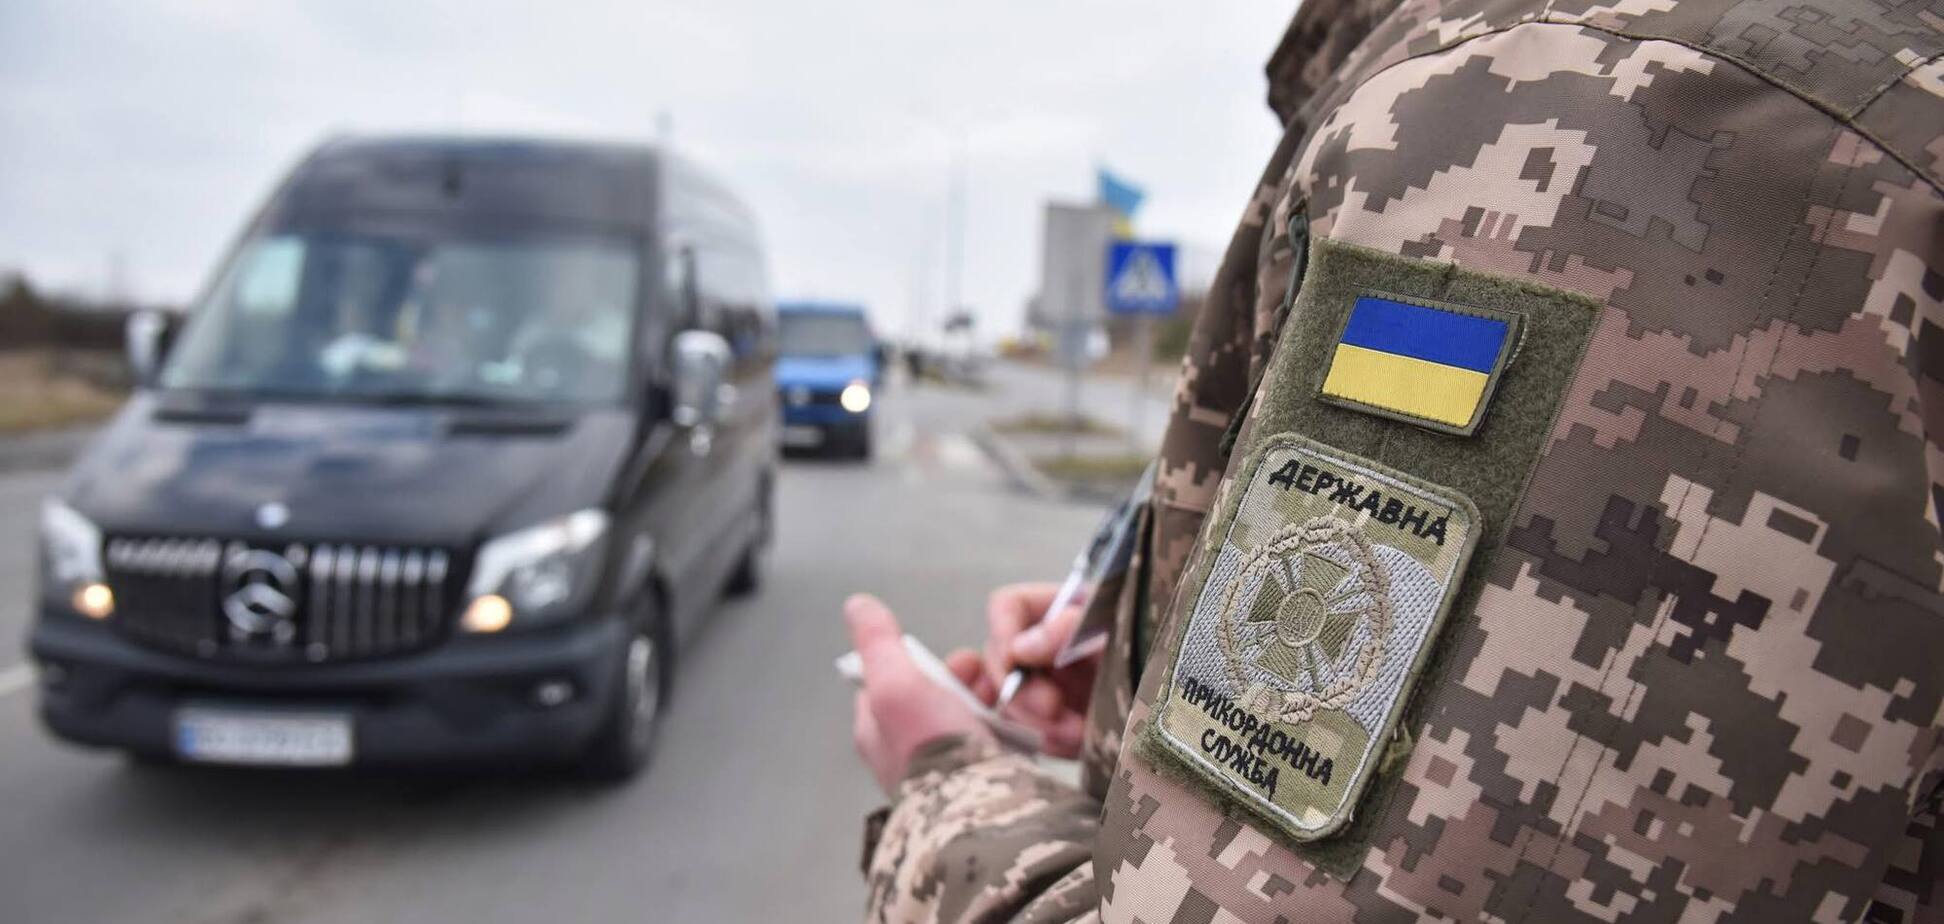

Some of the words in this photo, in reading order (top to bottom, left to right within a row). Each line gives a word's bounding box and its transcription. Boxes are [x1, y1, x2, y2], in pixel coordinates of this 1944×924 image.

[1268, 458, 1448, 546] ДЕРЖАВНА
[1182, 677, 1334, 786] ПРИКОРДОННА
[1200, 727, 1280, 798] СЛУЖБА
